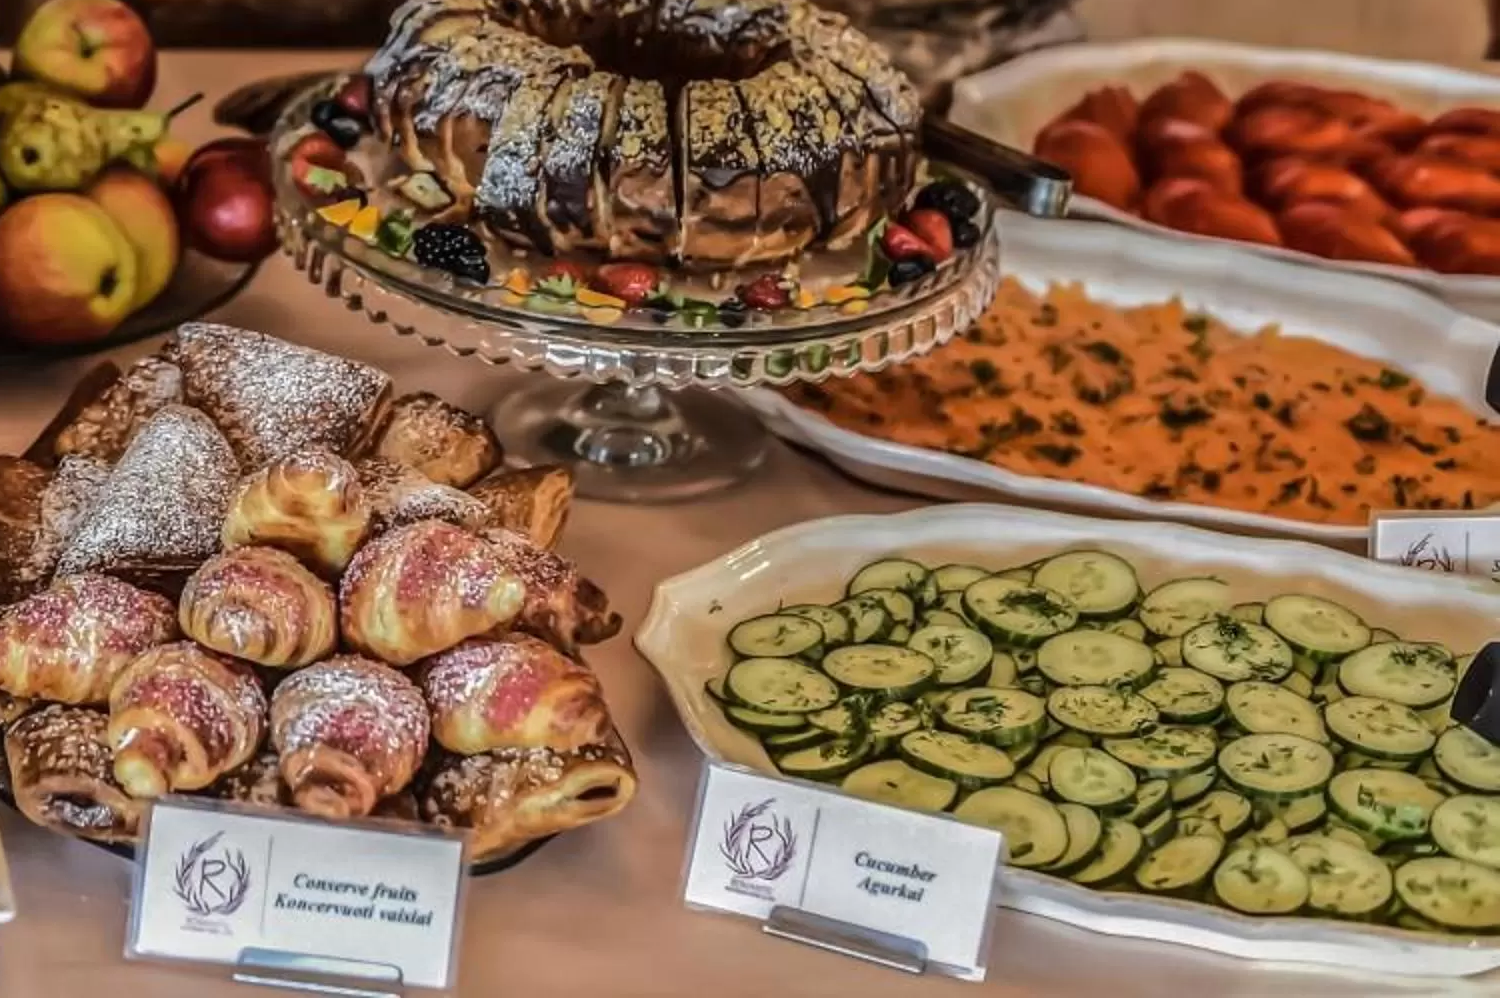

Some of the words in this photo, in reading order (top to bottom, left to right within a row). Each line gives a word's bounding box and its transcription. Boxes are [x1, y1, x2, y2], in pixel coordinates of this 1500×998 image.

[854, 850, 938, 883] Cucumber
[293, 872, 369, 897] Conserve
[370, 881, 419, 903] fruits
[857, 876, 925, 902] Agurkai
[274, 891, 375, 920] Koncervuoti
[379, 906, 434, 928] vaisiai
